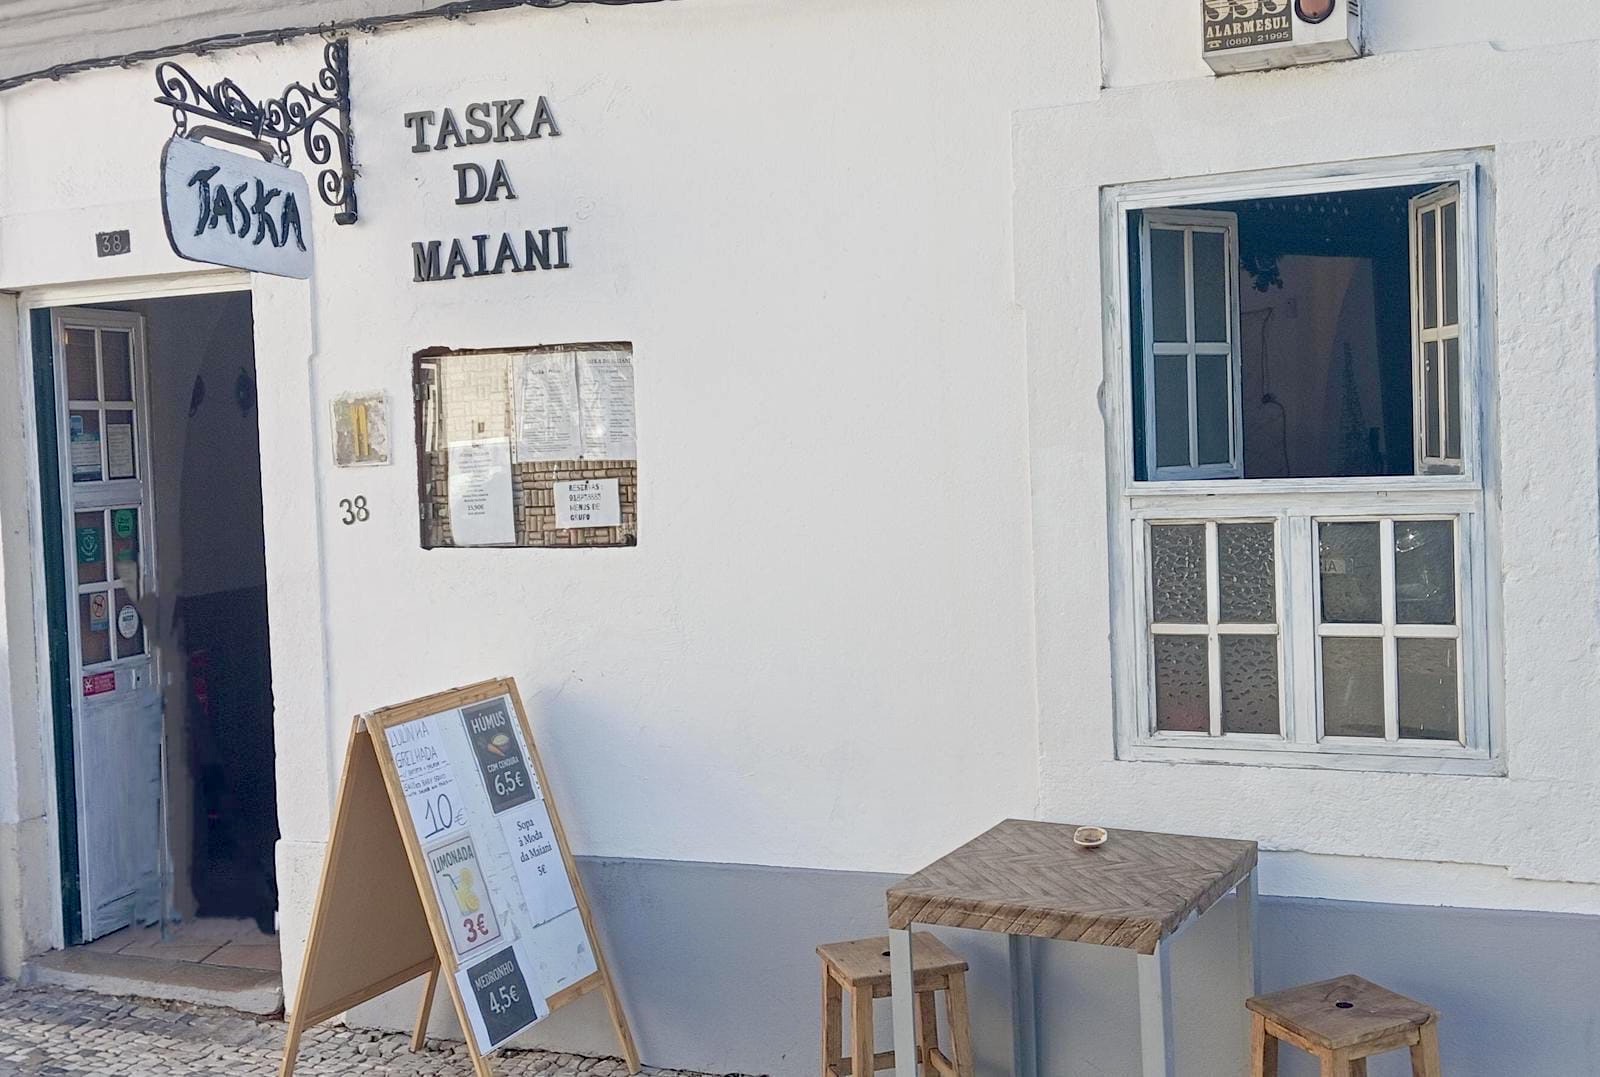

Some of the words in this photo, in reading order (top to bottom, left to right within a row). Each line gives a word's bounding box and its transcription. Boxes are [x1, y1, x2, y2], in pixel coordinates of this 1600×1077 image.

[1206, 16, 1289, 38] ALARMESUL
[1257, 32, 1289, 42] 21995
[404, 96, 561, 153] TASKA
[453, 159, 519, 205] DA
[187, 165, 307, 252] TASKA
[102, 234, 122, 253] 38
[412, 227, 571, 282] MAIANI
[339, 495, 370, 525] 38
[471, 710, 506, 734] HÚMUS
[494, 770, 525, 796] 6,5€
[516, 819, 534, 831] Sopa
[523, 830, 543, 845] Moda
[433, 844, 475, 874] LIMONADA
[520, 851, 530, 863] da
[537, 864, 547, 876] 5€
[463, 913, 489, 943] 3€
[475, 960, 515, 991] MEDRONHO
[489, 985, 520, 1014] 4,5€
